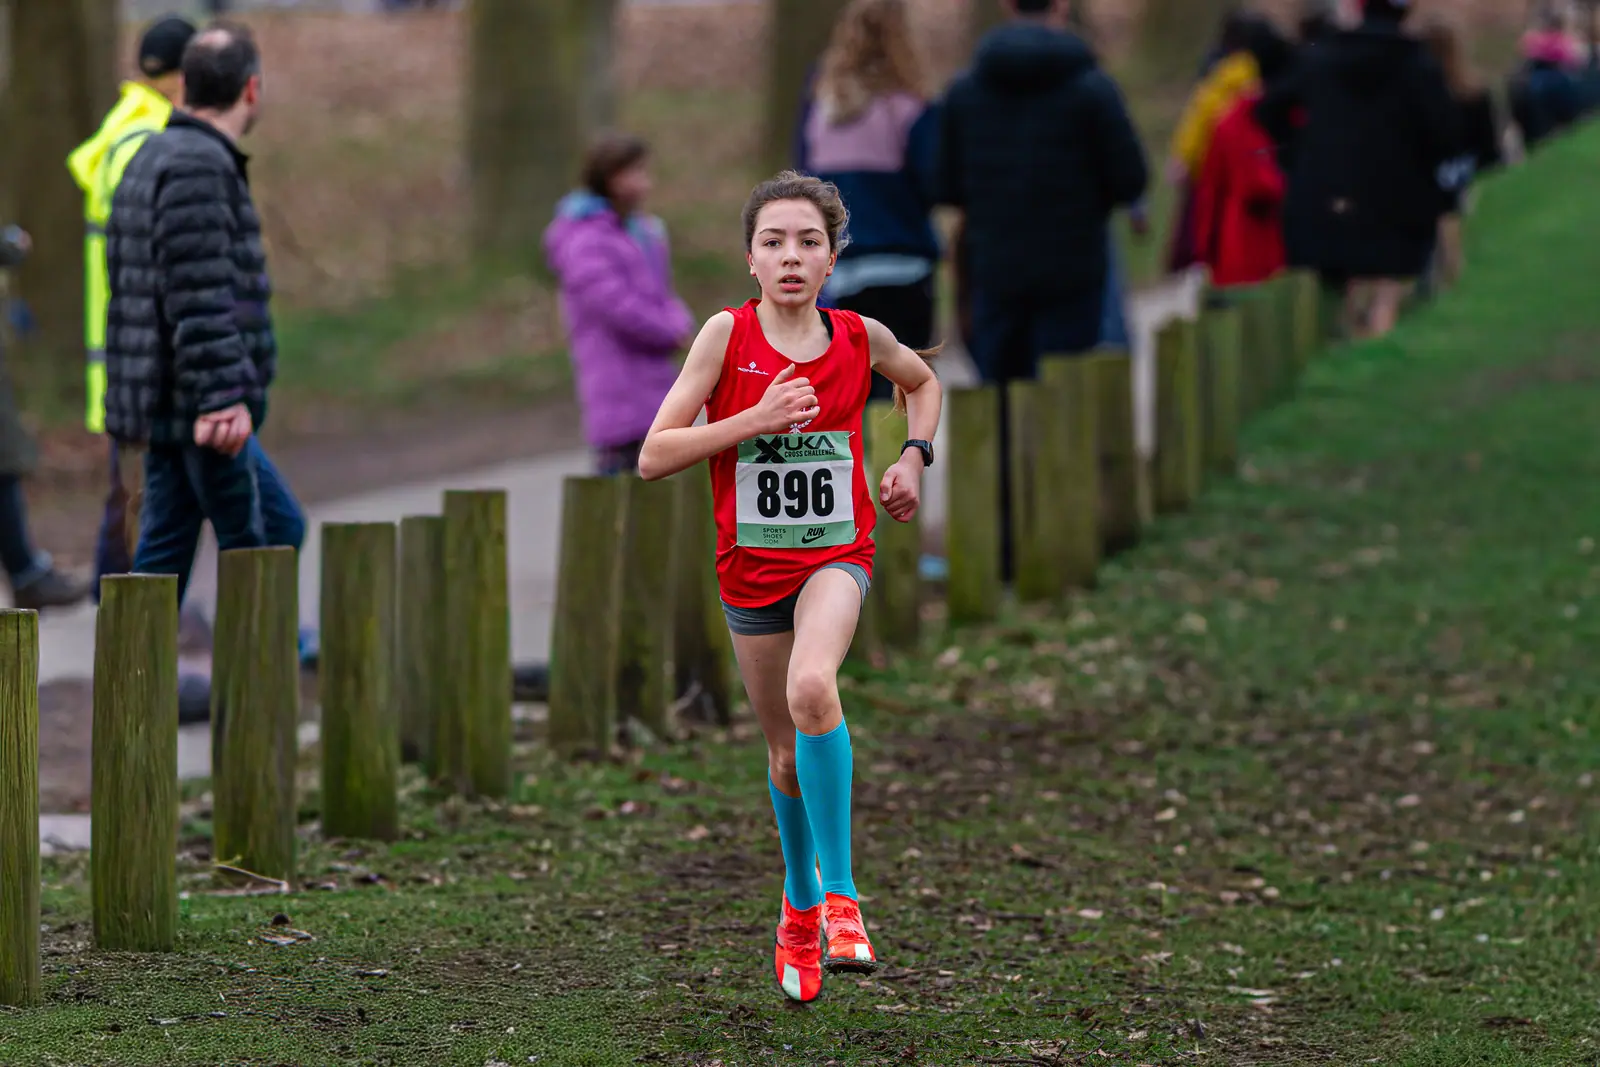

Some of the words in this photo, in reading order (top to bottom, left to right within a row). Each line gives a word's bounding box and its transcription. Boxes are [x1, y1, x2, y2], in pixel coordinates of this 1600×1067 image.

[784, 450, 804, 458] CROSS
[804, 449, 836, 457] CHALLENGE
[757, 468, 834, 518] 896
[807, 527, 826, 537] RUN
